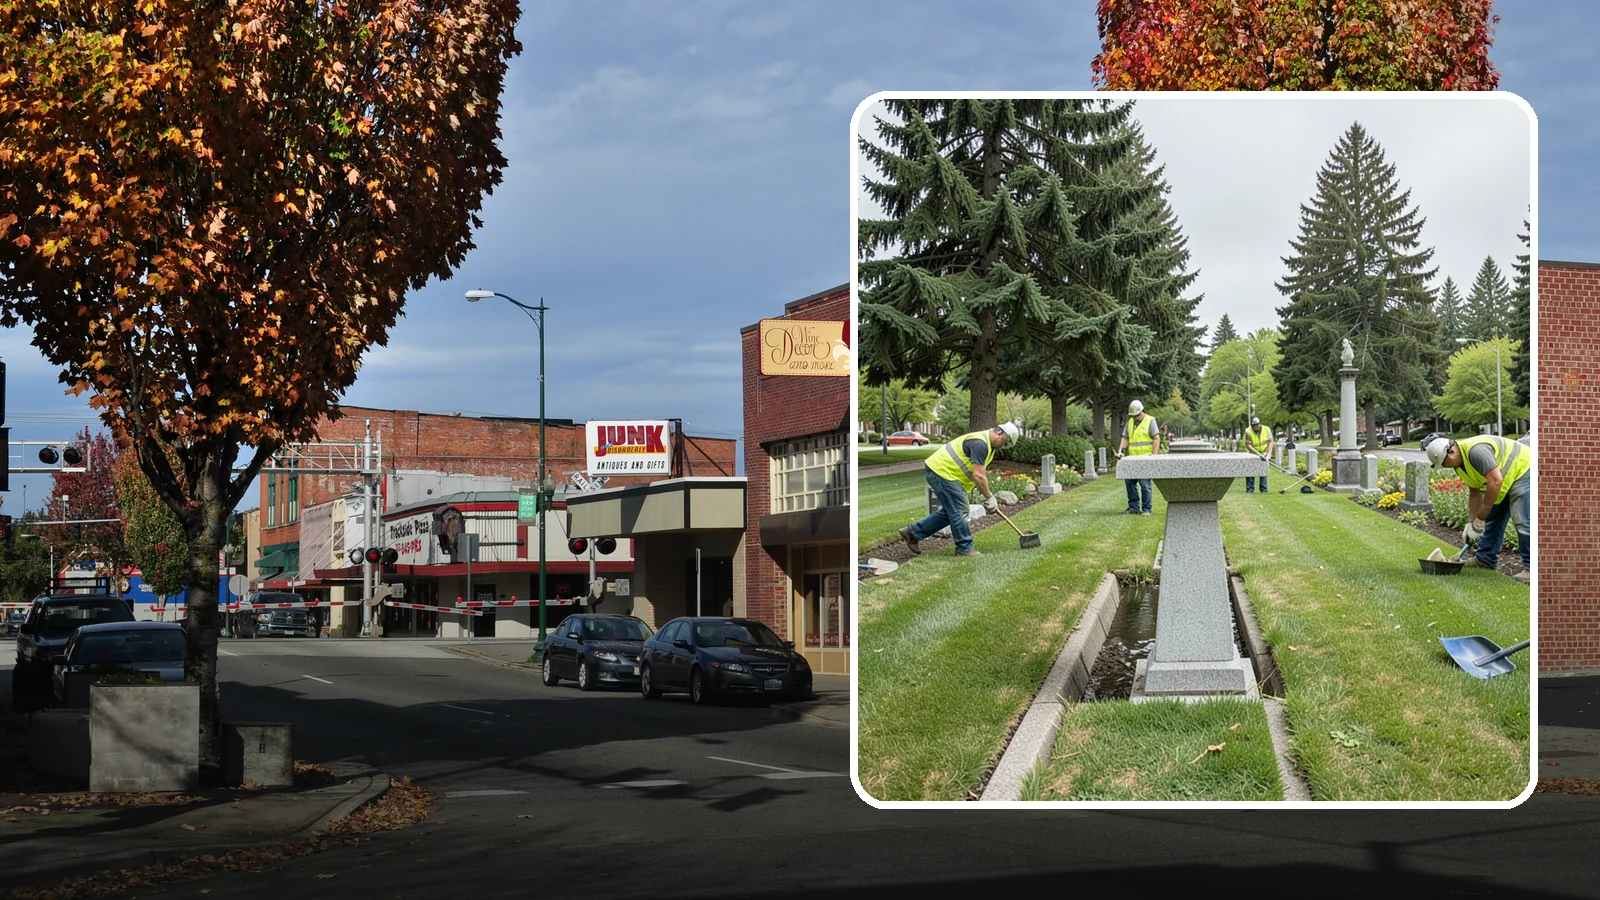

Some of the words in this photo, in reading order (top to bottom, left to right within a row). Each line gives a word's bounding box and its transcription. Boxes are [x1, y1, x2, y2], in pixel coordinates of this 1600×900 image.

[596, 425, 665, 457] JUNK
[597, 461, 627, 469] ANTIQUES
[631, 461, 643, 469] AND
[647, 461, 665, 469] GIFTS
[390, 522, 412, 539] Trackside
[414, 519, 429, 534] Pizza
